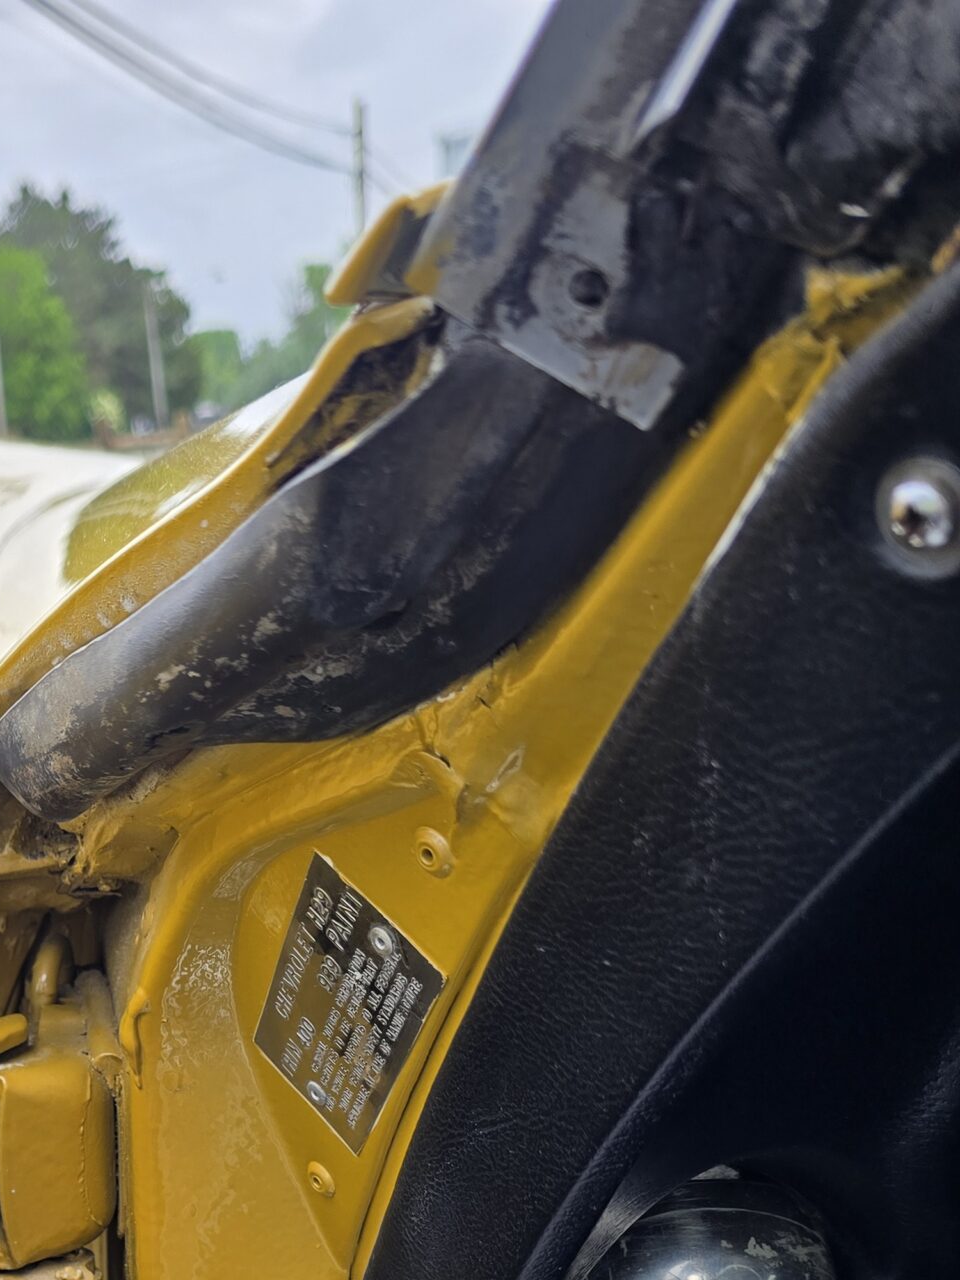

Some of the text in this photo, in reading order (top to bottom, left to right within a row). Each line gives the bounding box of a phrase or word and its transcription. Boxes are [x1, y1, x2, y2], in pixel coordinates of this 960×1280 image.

[326, 890, 362, 950] PAINT
[334, 947, 365, 1007] CORPORATION
[366, 990, 382, 1010] ALL
[377, 972, 407, 1025] STANDARDS
[339, 1016, 352, 1036] THE
